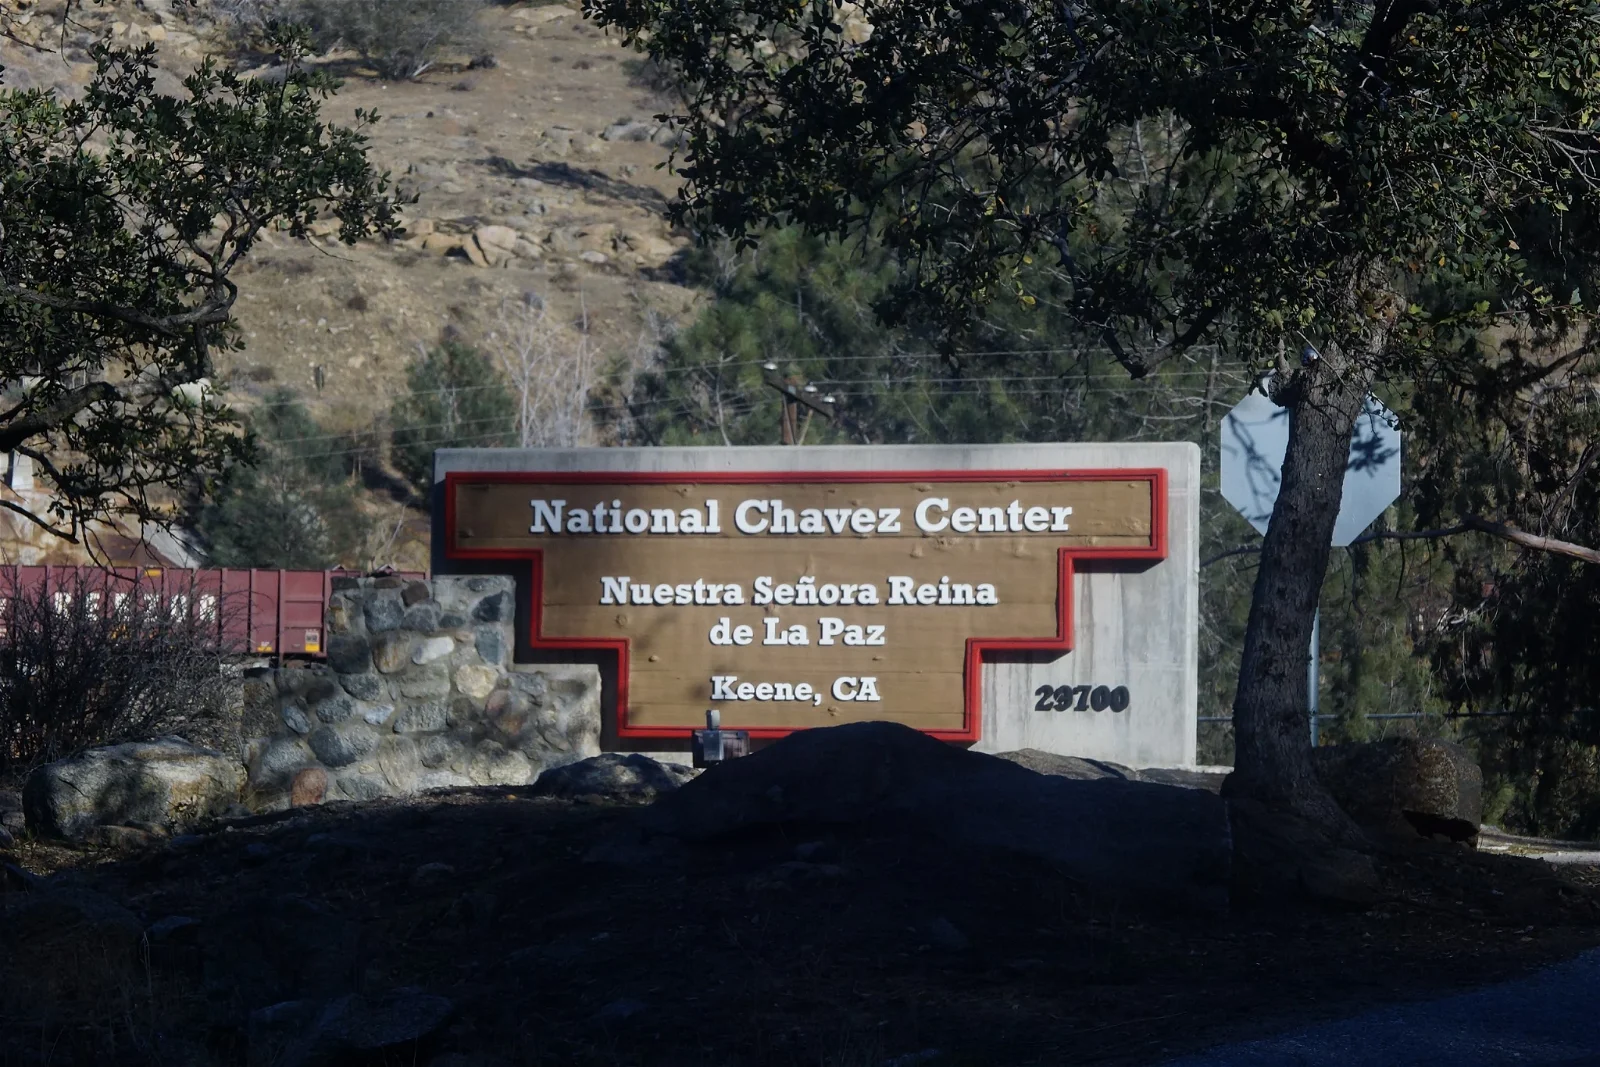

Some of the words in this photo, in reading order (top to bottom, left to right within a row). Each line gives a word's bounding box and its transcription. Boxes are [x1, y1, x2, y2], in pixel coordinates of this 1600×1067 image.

[530, 499, 721, 534] National
[734, 499, 901, 534] Chavez
[915, 497, 1073, 533] Center
[600, 576, 745, 605] Nuestra
[753, 575, 880, 605] Señora
[887, 575, 999, 605] Reina
[709, 617, 754, 645] de
[763, 617, 810, 645] La
[818, 617, 886, 645] Paz
[711, 675, 822, 706] Keene,
[832, 676, 881, 701] CA
[1034, 684, 1130, 713] 29700
